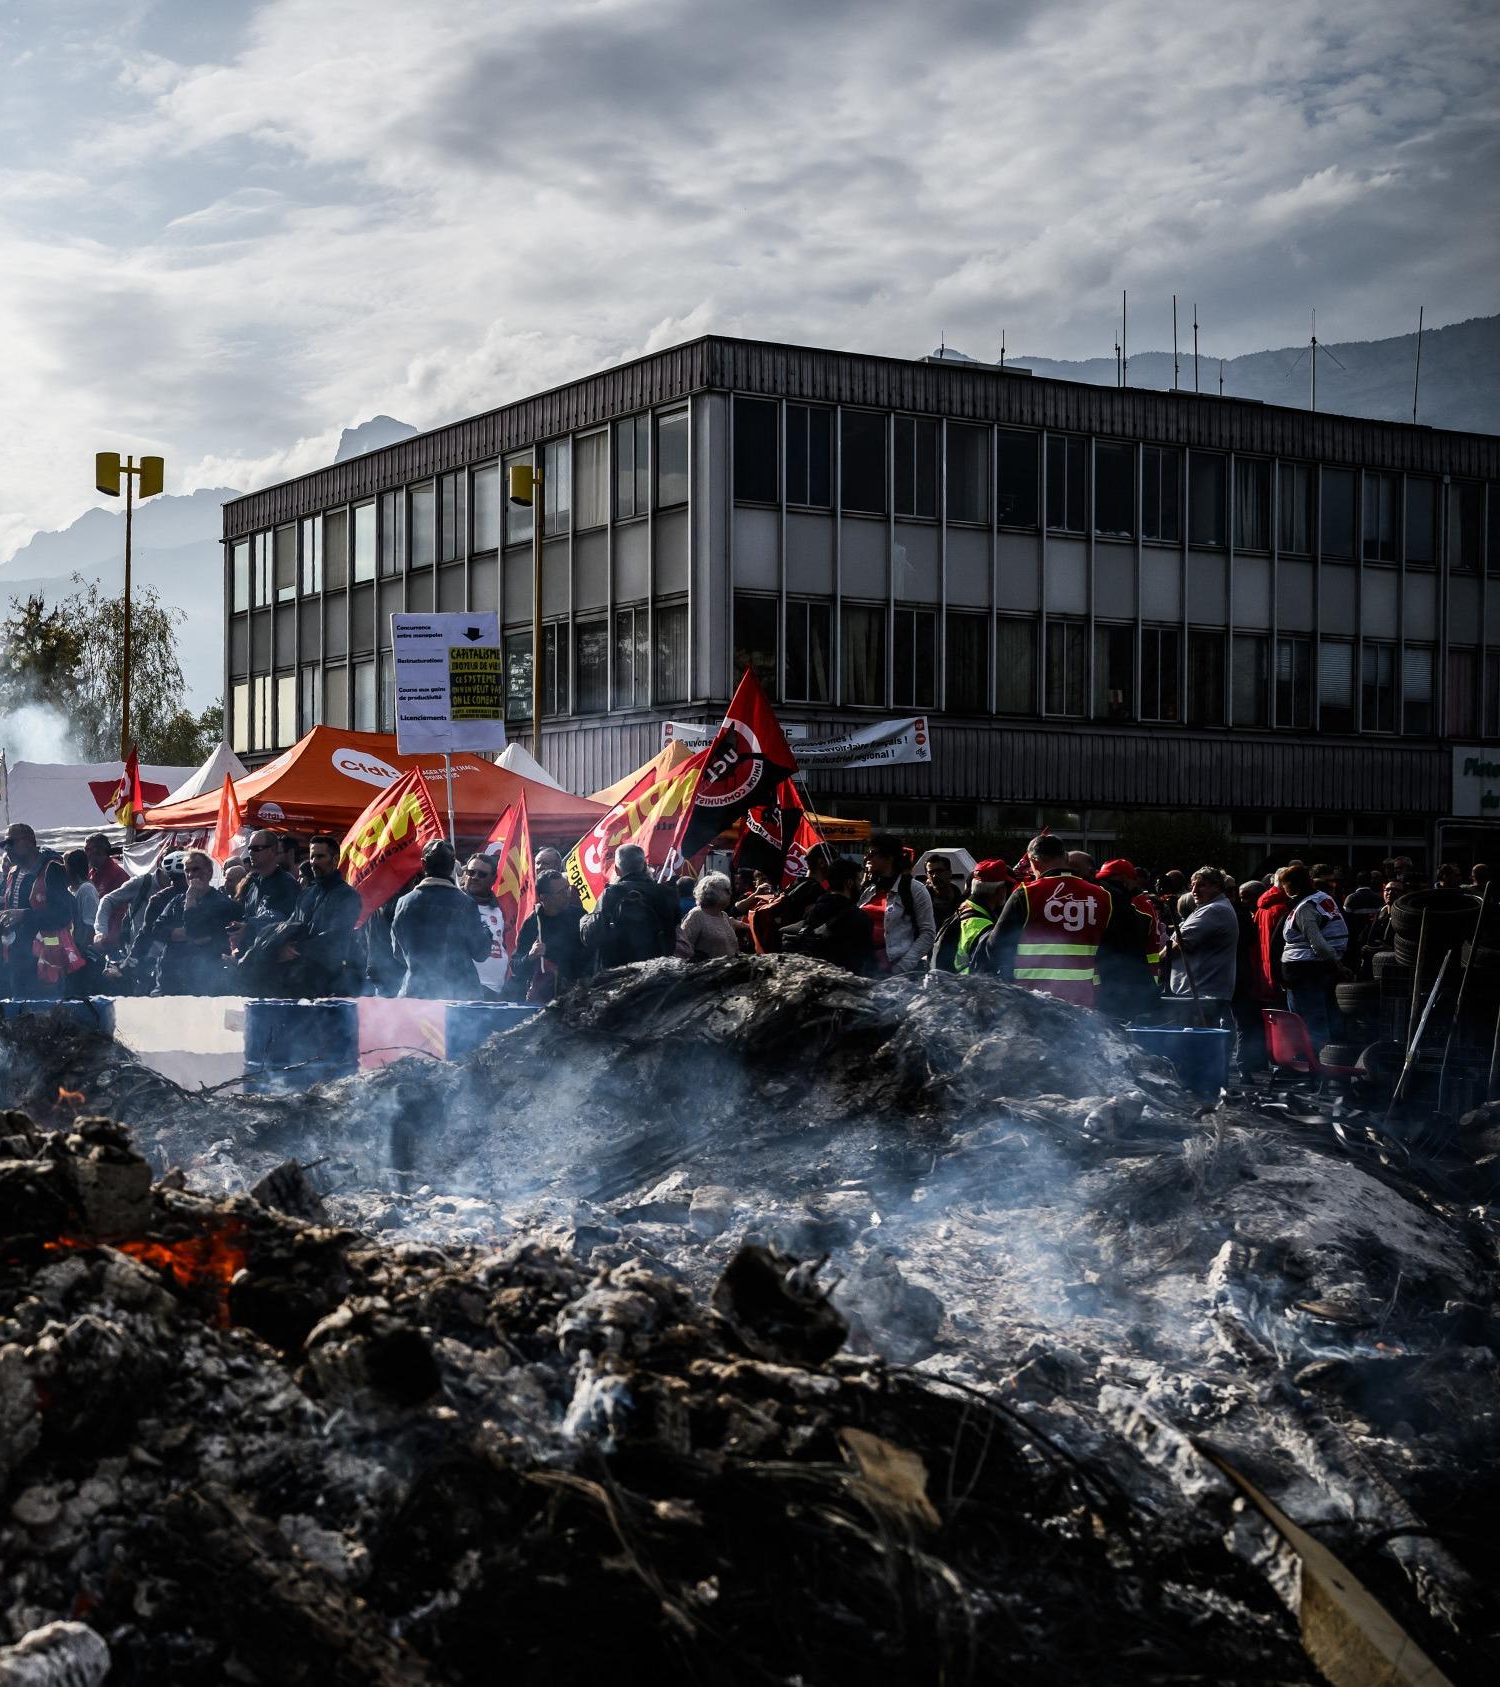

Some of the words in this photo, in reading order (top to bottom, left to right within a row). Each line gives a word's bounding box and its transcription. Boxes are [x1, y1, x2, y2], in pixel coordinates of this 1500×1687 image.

[480, 661, 488, 670] DE
[1045, 882, 1089, 902] la
[1043, 895, 1098, 932] cgt
